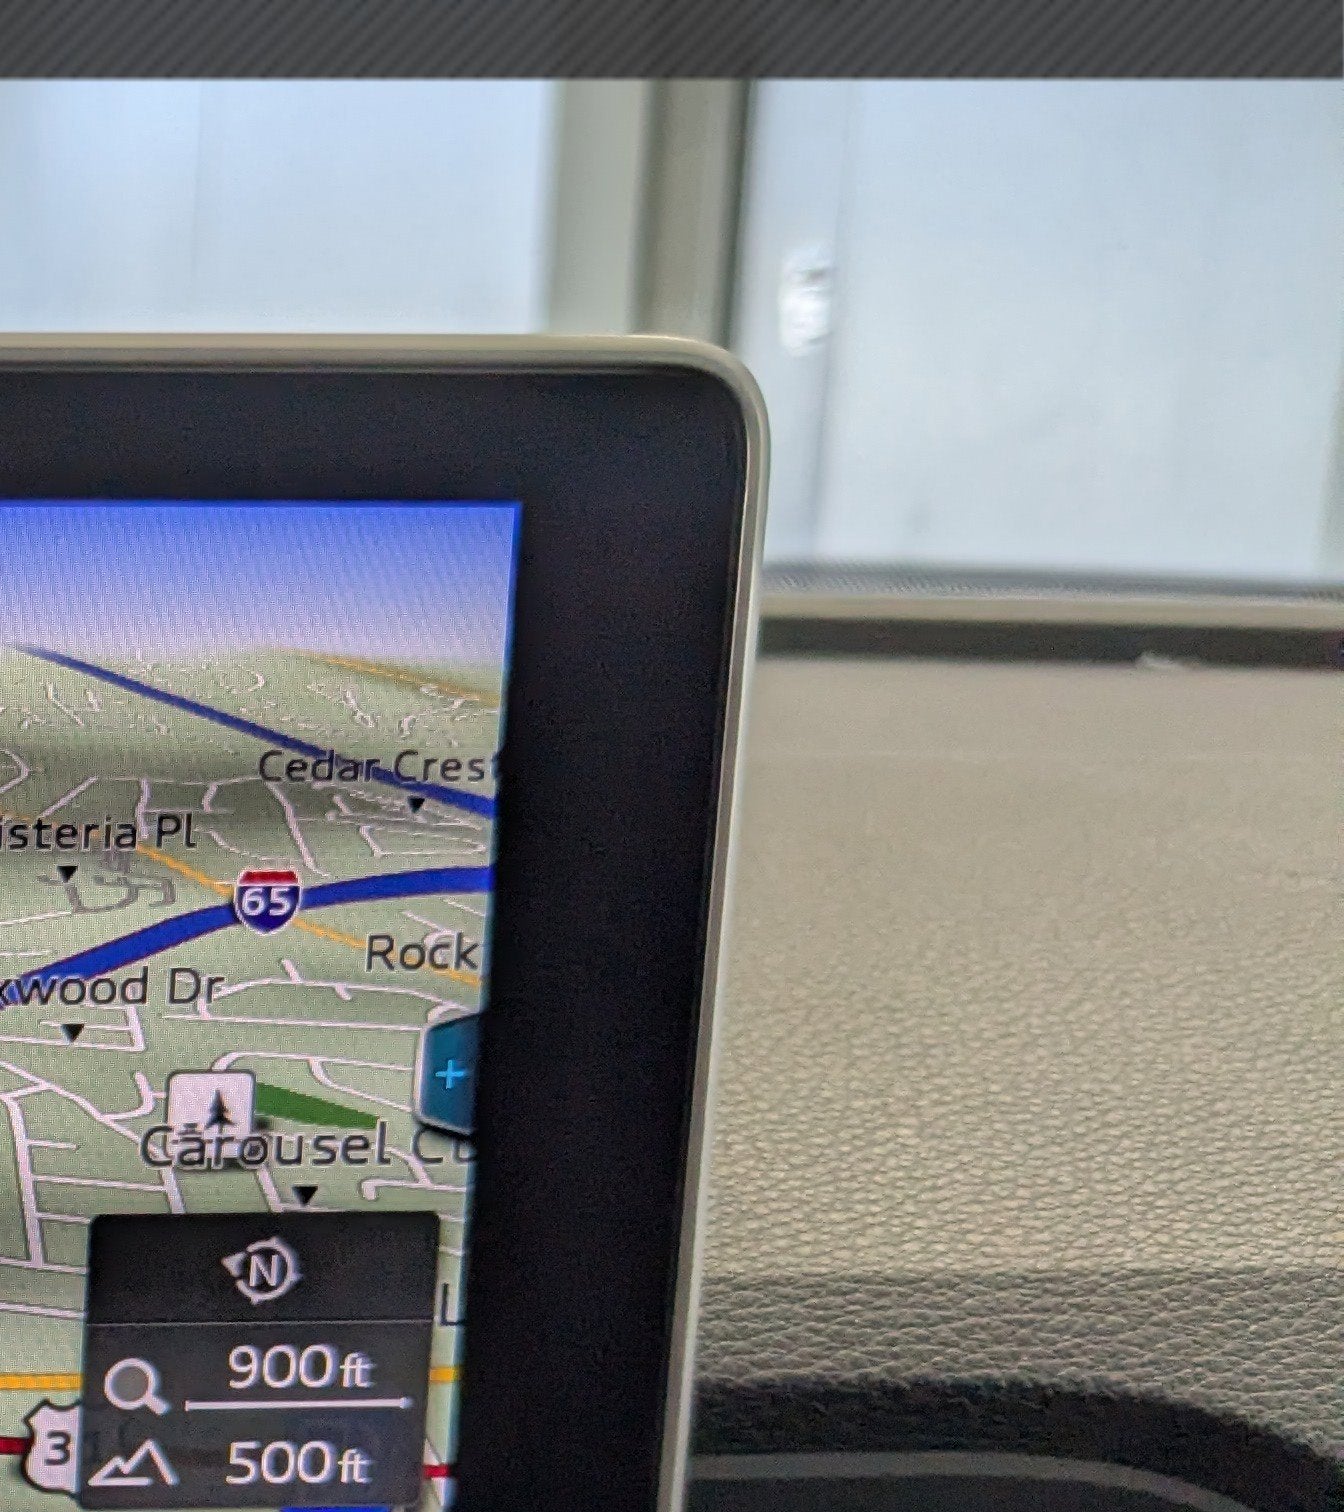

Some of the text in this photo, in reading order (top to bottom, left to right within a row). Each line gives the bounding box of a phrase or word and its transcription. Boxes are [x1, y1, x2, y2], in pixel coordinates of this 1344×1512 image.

[258, 749, 498, 783] Cedar Cres
[155, 812, 197, 848] Pl
[240, 887, 292, 917] 65
[365, 931, 481, 972] Rock
[169, 967, 225, 1004] Dr
[140, 1120, 392, 1167] Carousel
[248, 1253, 279, 1288] N
